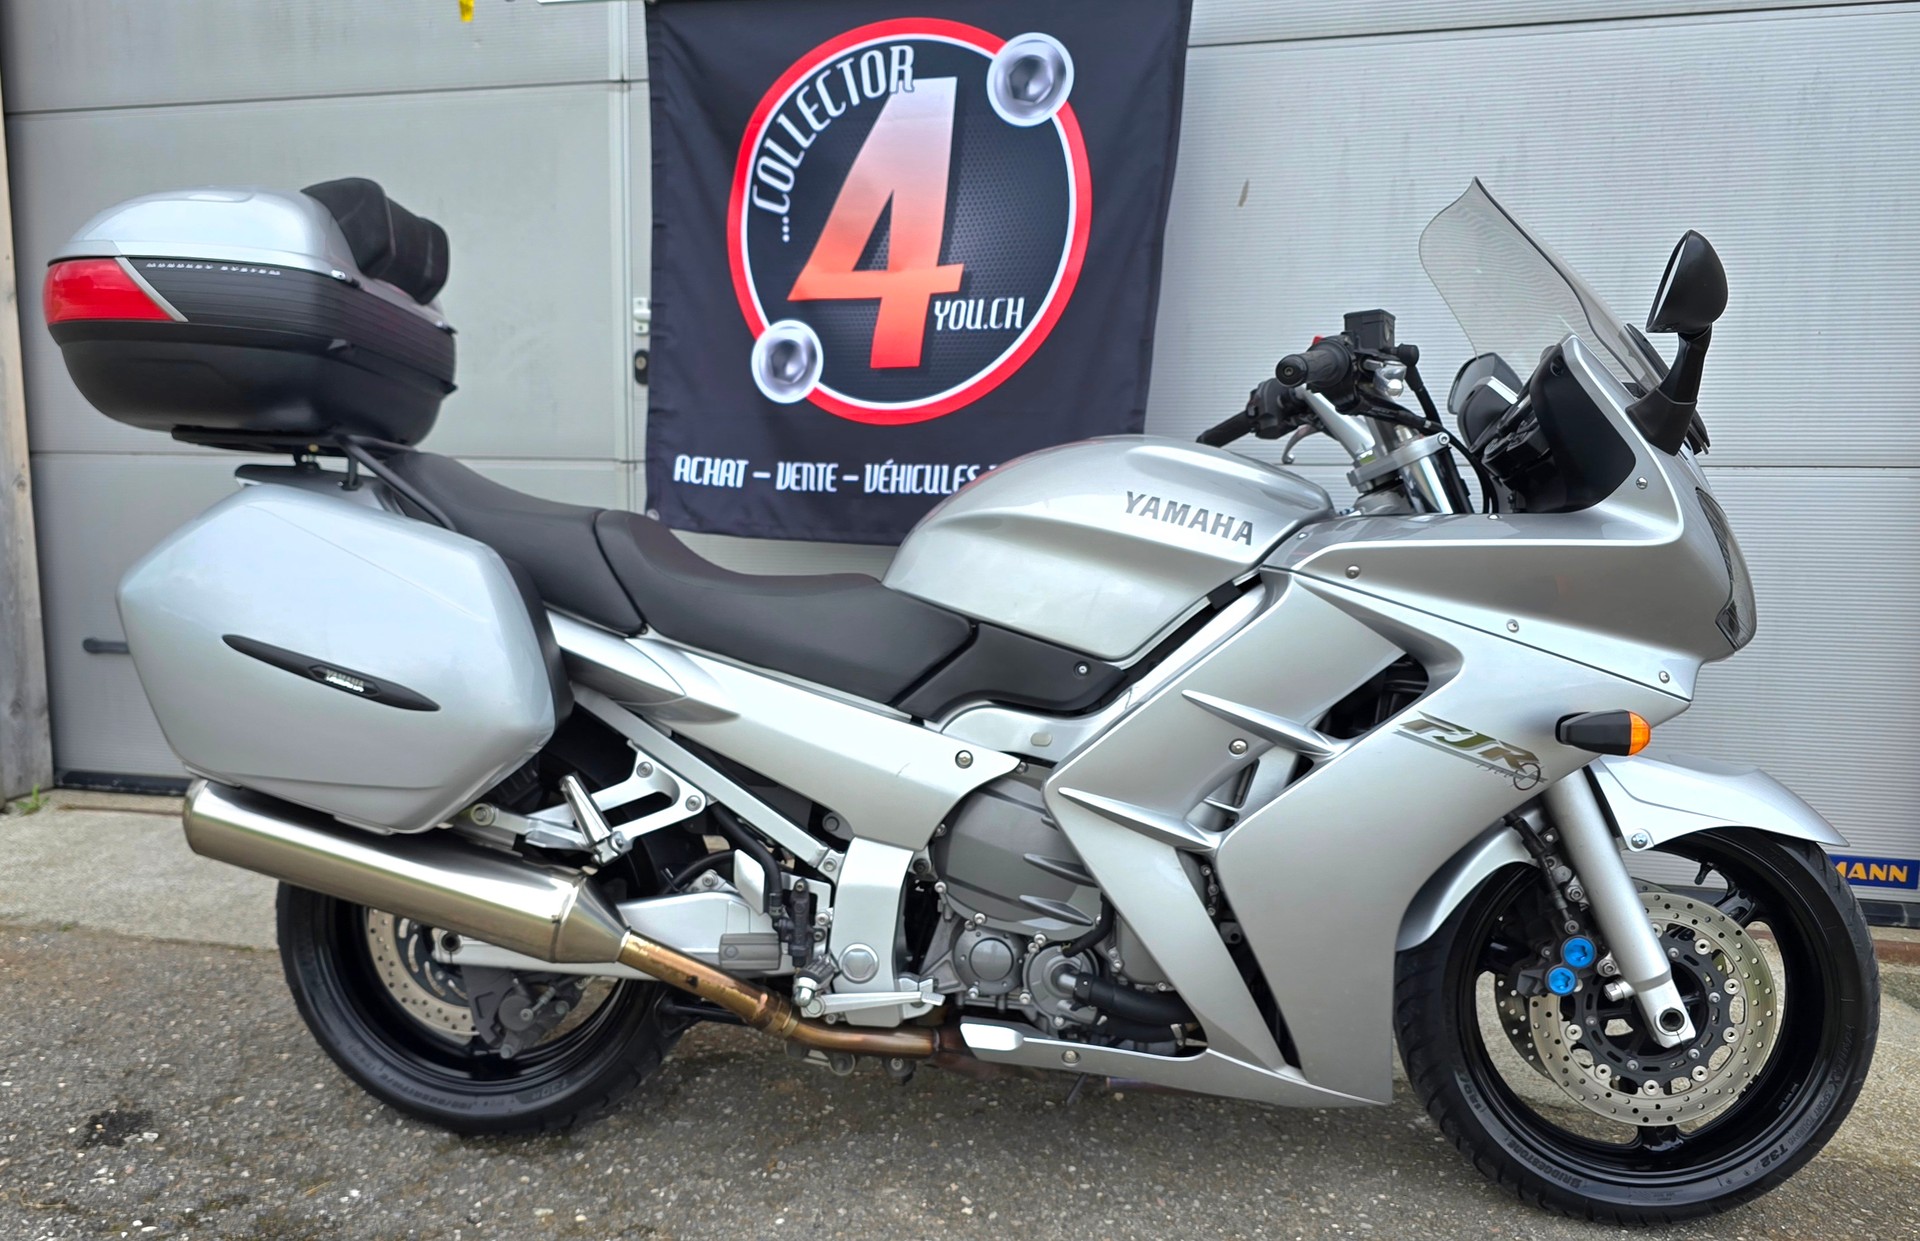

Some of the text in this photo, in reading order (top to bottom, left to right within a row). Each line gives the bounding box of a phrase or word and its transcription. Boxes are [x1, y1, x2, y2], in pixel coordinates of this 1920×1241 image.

[787, 76, 965, 369] 4
[934, 297, 1025, 331] YOU.CH
[673, 454, 750, 488] ACHAT
[776, 462, 839, 492] VENTE
[1125, 490, 1254, 546] YAMAHA
[1400, 710, 1541, 775] FJR
[1505, 1140, 1584, 1190] BRIDGESTONE
[1760, 1143, 1789, 1169] T32
